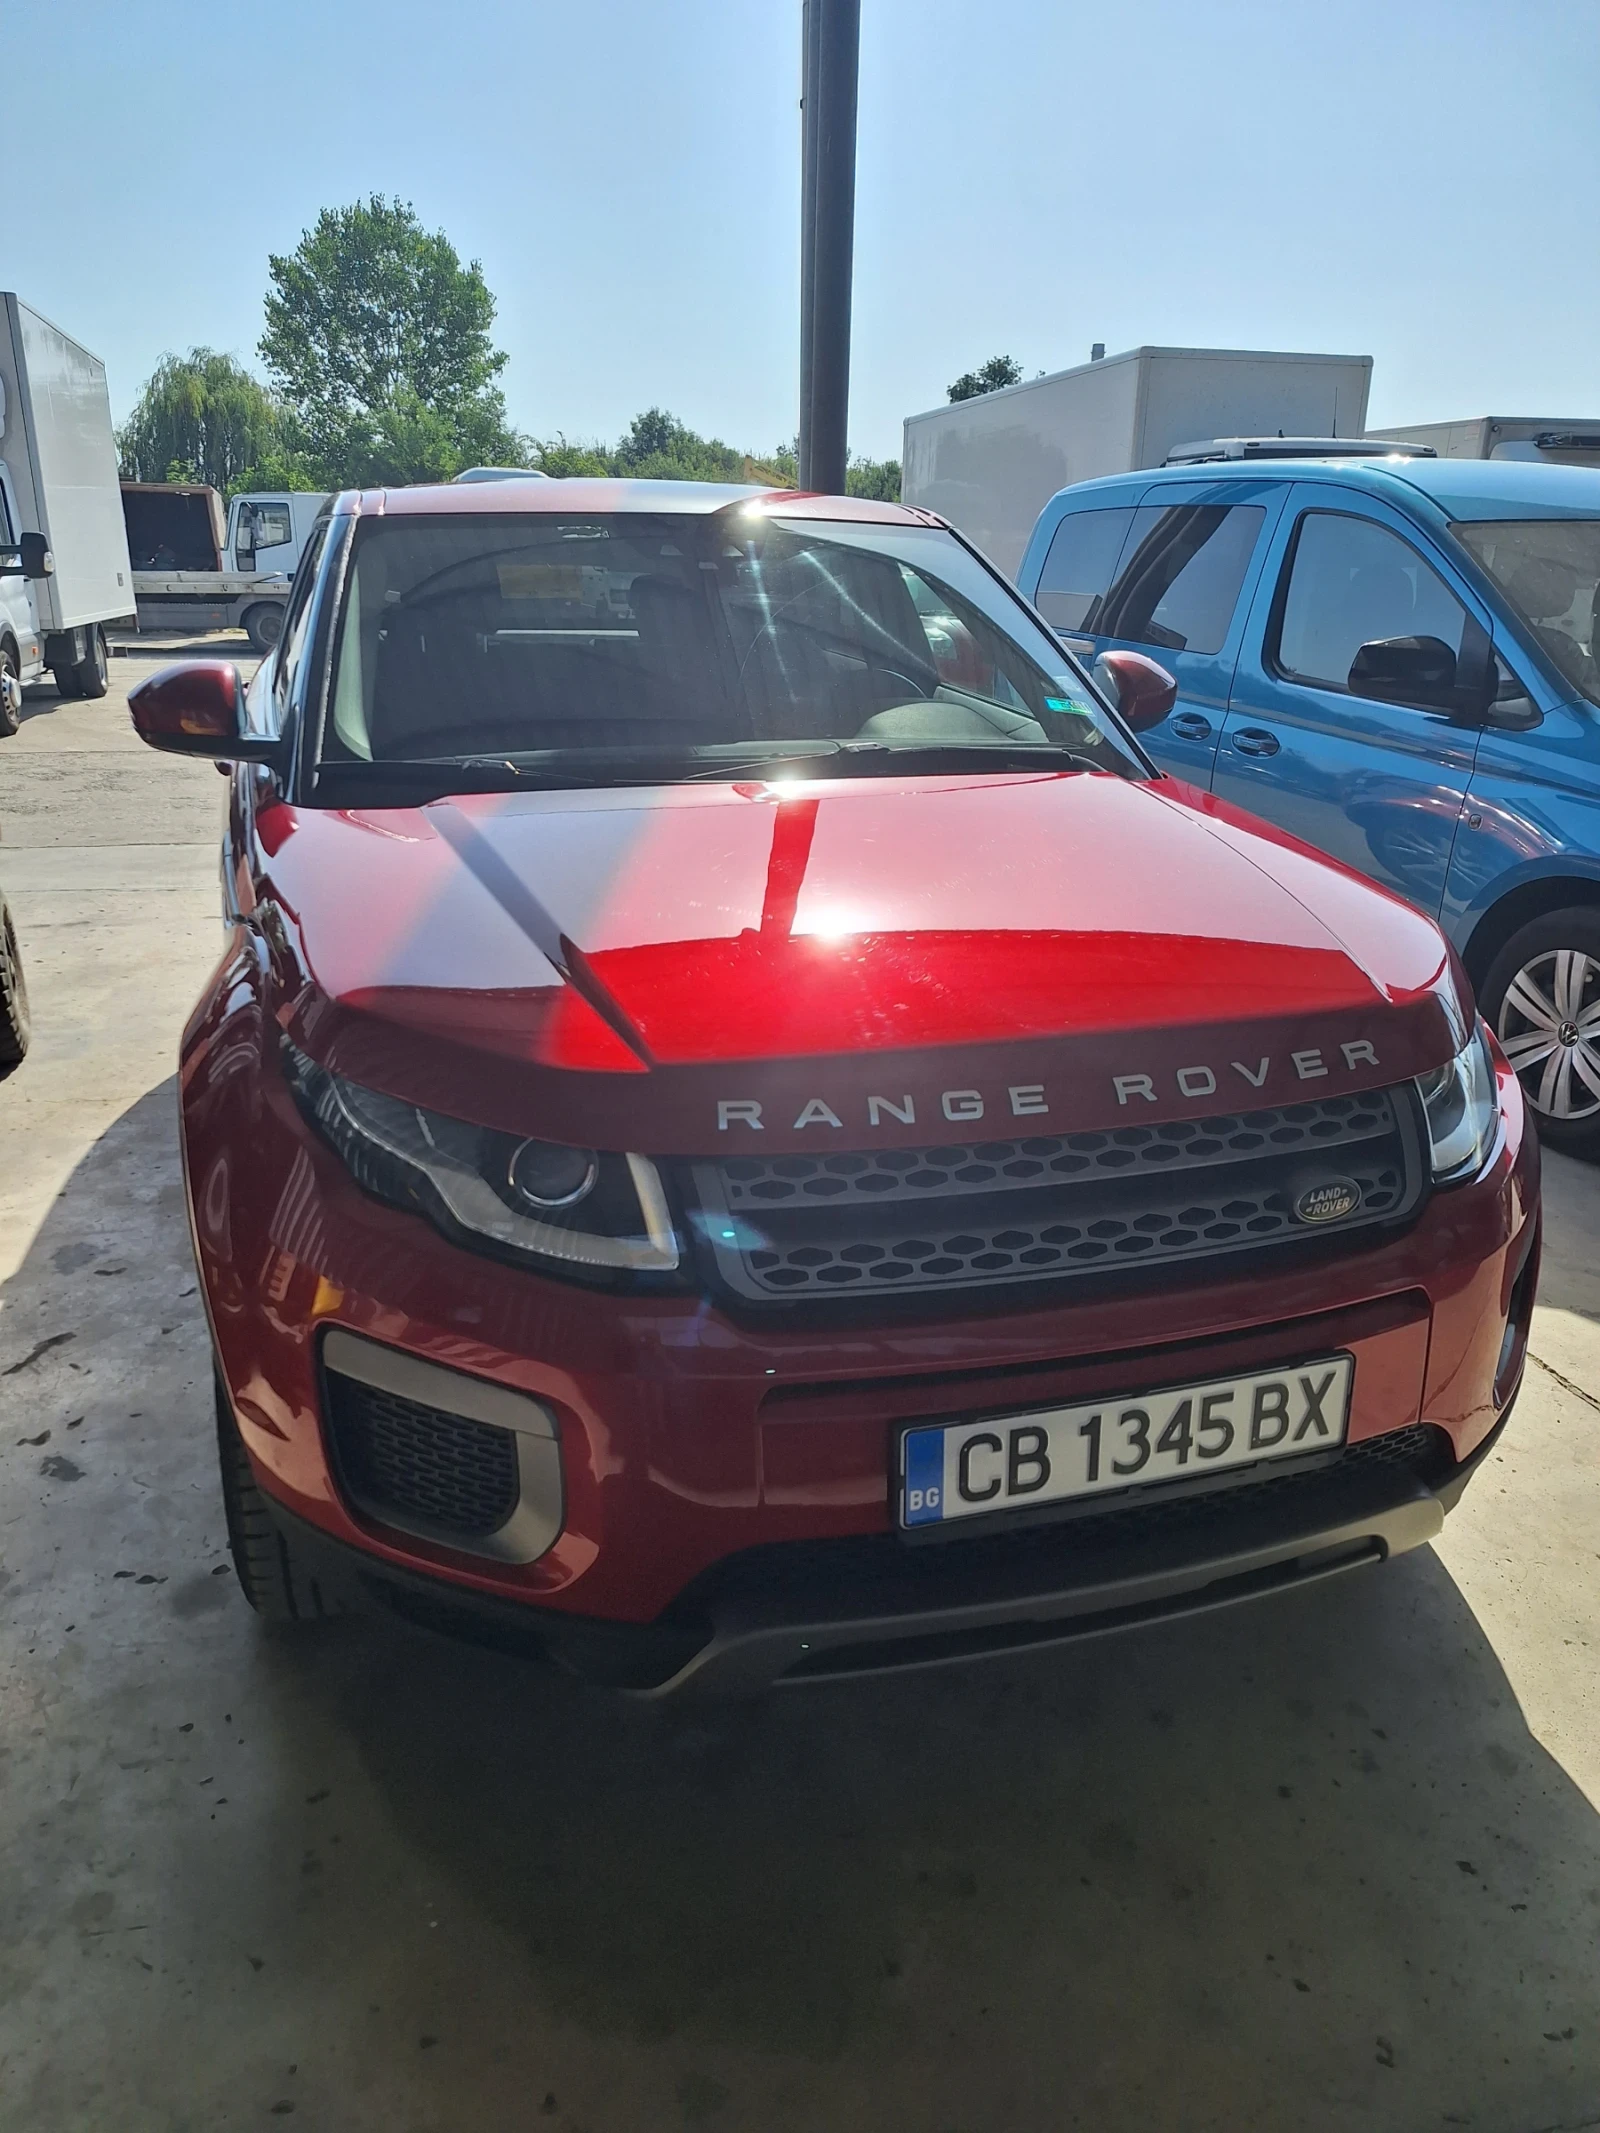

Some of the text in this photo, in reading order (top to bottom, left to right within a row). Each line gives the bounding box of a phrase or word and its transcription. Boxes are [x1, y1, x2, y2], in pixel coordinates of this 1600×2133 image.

[717, 1039, 1380, 1131] RANGE ROVER
[1310, 1187, 1341, 1203] LAND
[1312, 1197, 1350, 1215] ROVER
[958, 1371, 1337, 1502] CB 1345 BX
[909, 1486, 940, 1511] BG
